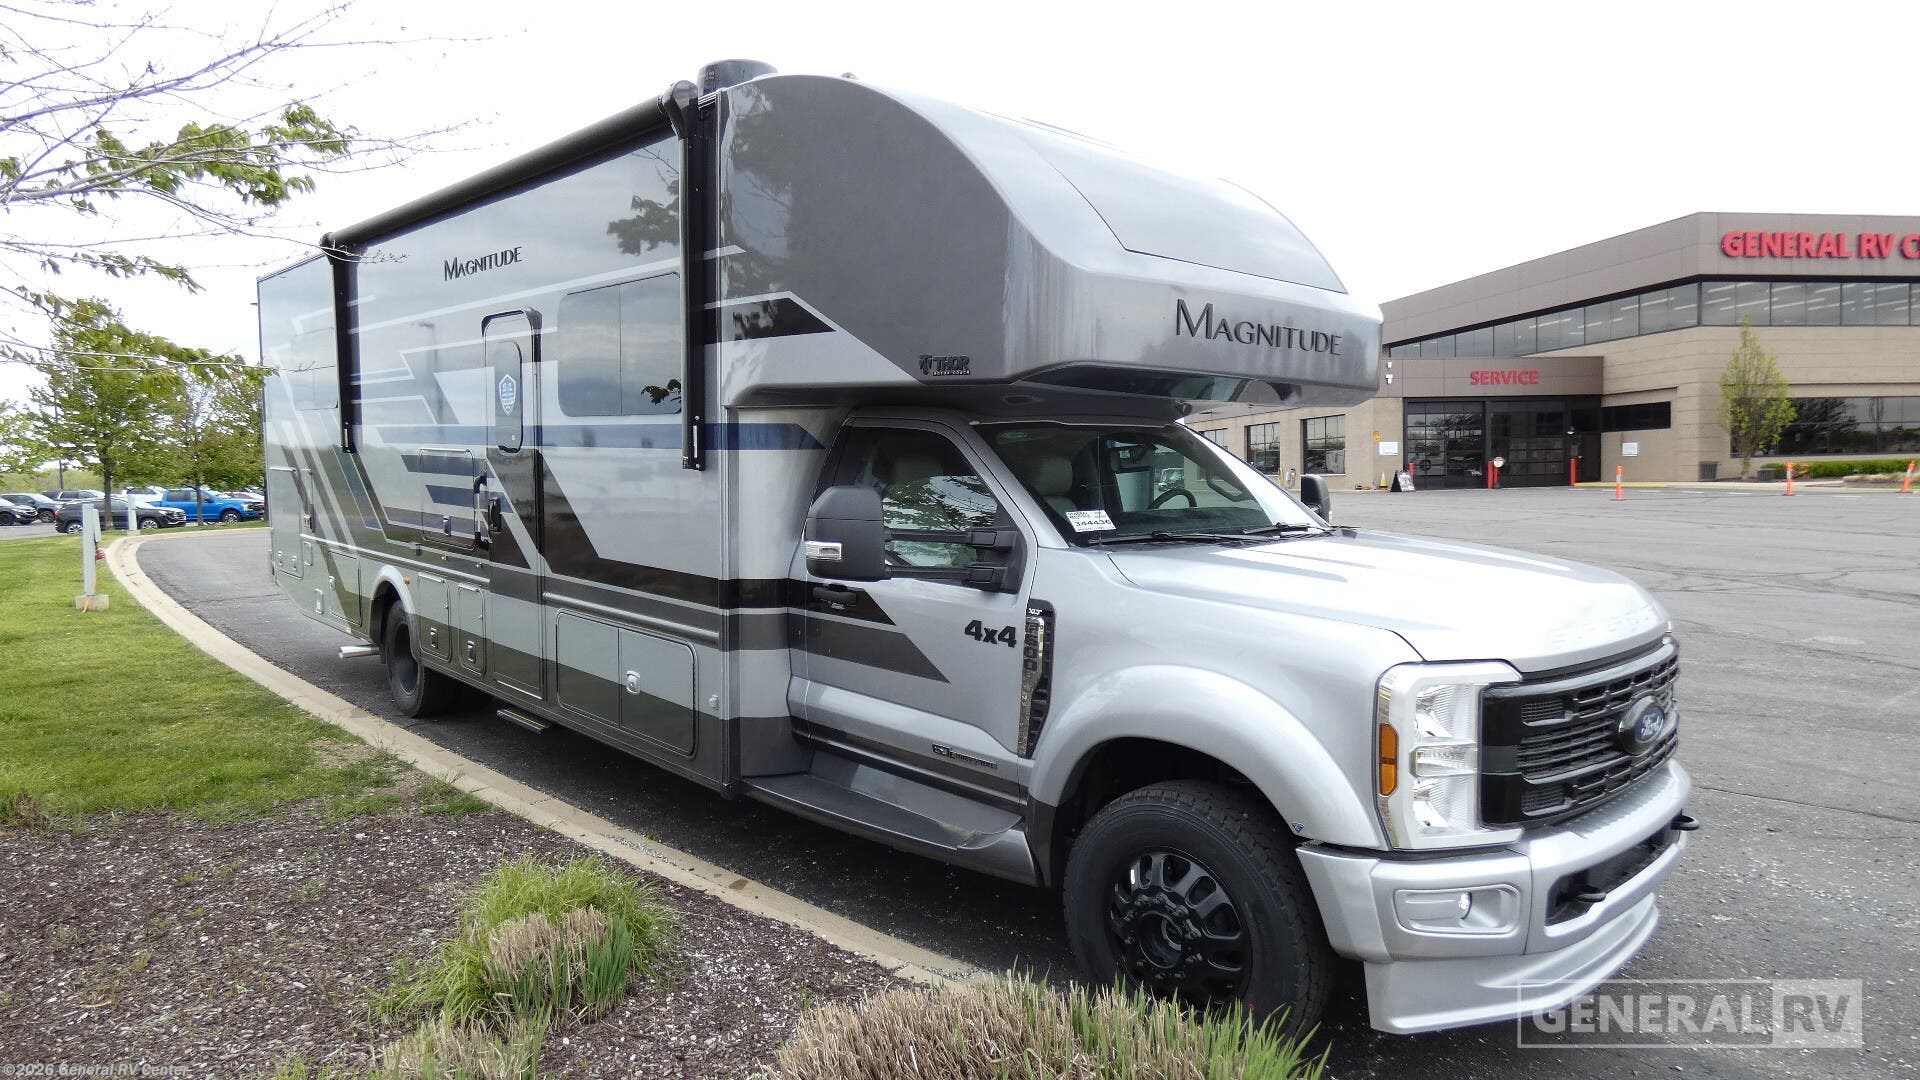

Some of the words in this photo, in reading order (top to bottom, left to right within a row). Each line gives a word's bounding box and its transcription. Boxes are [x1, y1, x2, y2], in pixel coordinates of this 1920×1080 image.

[1721, 231, 1852, 258] GENERAL
[1857, 232, 1896, 259] RV
[933, 356, 970, 371] THOR
[1470, 369, 1540, 385] SERVICE
[1028, 607, 1043, 616] XLT
[964, 619, 1017, 649] 4x4
